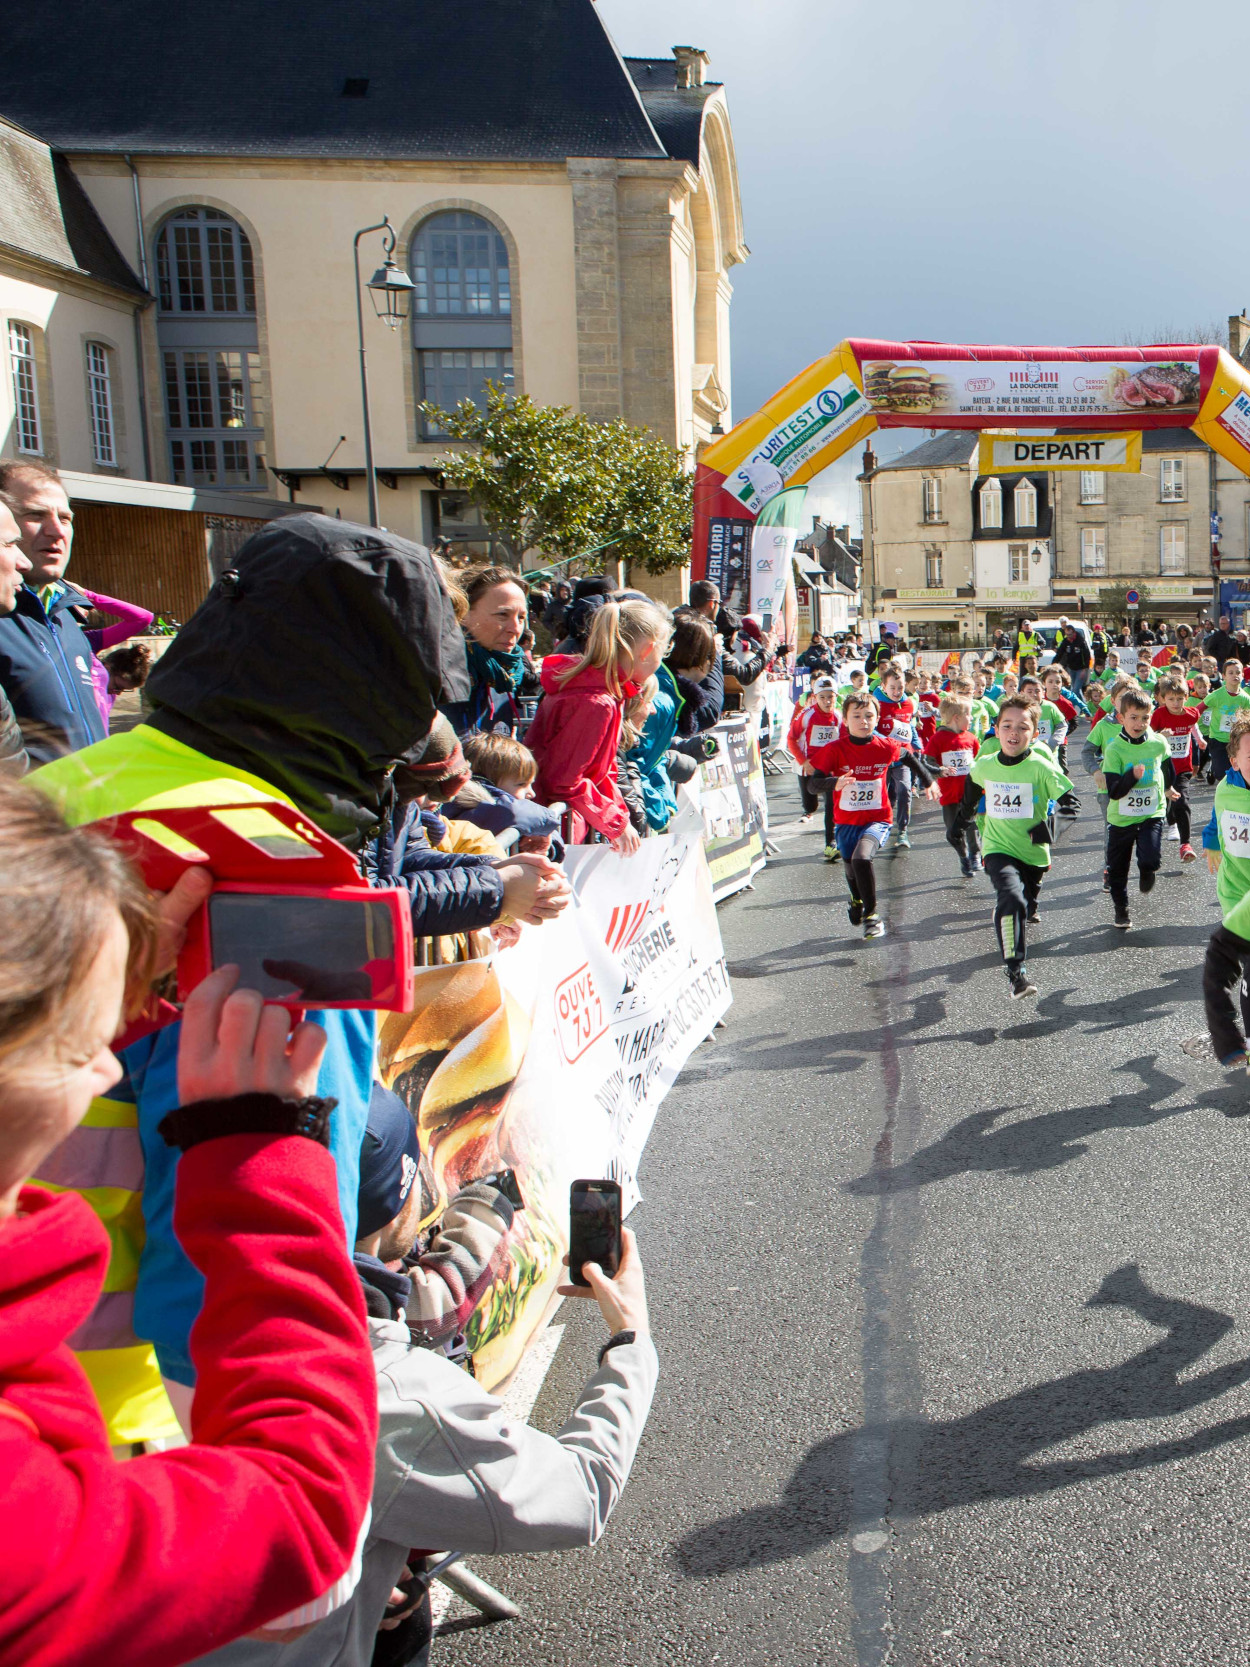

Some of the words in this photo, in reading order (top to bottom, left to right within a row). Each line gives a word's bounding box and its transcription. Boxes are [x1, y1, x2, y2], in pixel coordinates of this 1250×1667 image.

[1021, 396, 1040, 404] MARCHÉ
[792, 418, 824, 447] AUTOMOBILE
[1014, 442, 1105, 460] DEPART
[708, 524, 724, 583] VERLORD
[900, 589, 954, 598] RESTAURANT
[1170, 742, 1187, 751] 337
[850, 790, 874, 802] 328
[993, 794, 1022, 807] 244
[1128, 797, 1151, 807] 296
[559, 973, 595, 1020] OUVE
